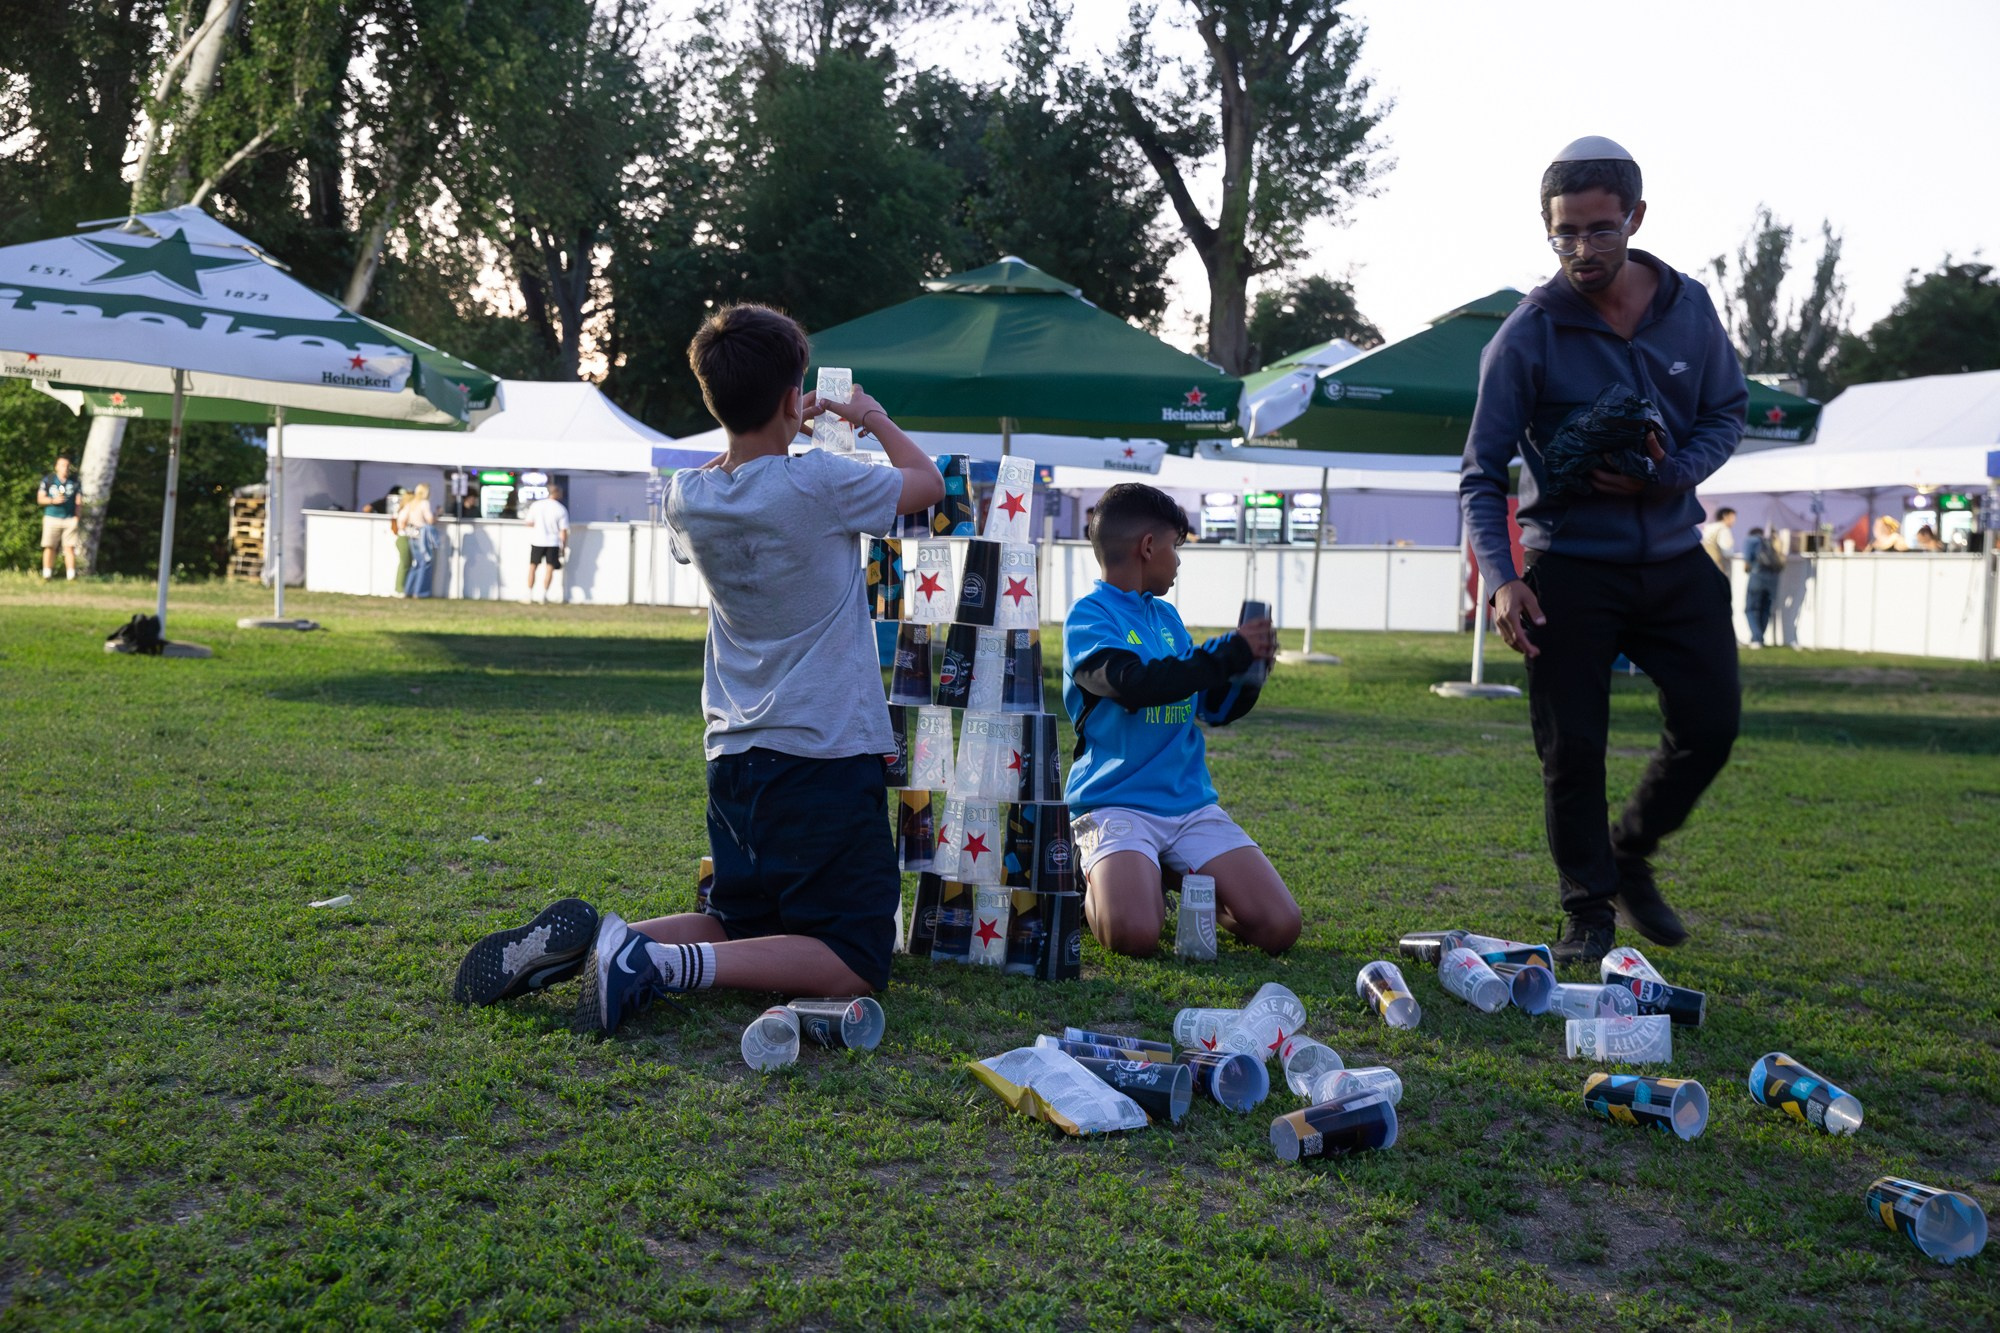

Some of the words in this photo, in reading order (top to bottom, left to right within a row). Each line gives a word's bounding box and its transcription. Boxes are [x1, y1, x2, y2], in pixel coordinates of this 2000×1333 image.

[28, 264, 73, 278] EST.
[224, 288, 269, 302] 1873
[321, 371, 392, 389] Heineken
[1162, 407, 1227, 422] Heineken
[1145, 706, 1161, 724] FLY
